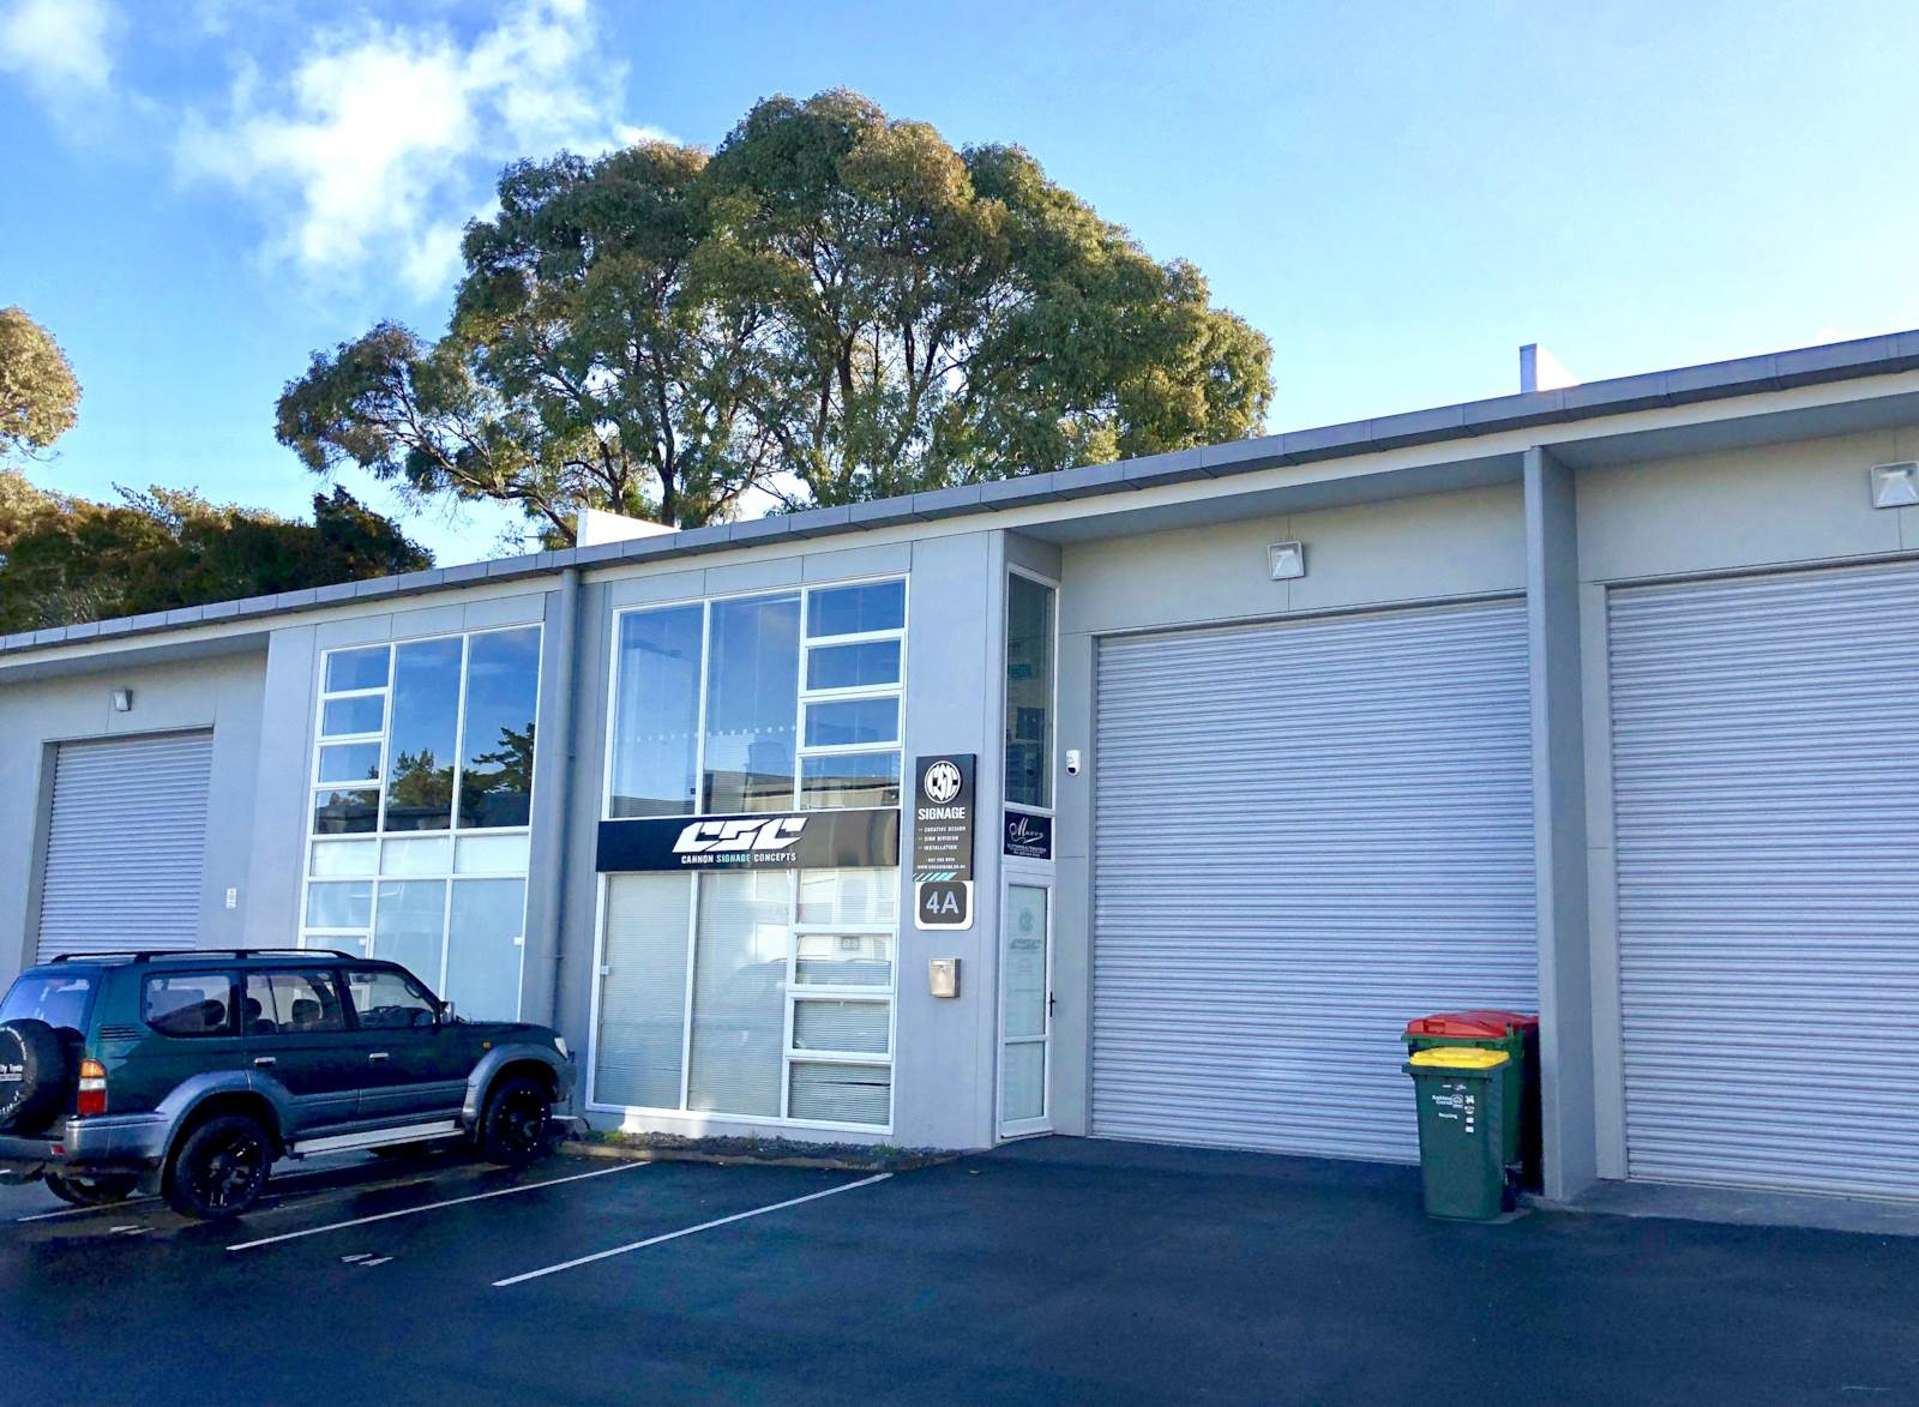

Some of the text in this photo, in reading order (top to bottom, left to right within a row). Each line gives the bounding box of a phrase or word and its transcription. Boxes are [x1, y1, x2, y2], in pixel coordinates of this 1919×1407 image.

[918, 807, 966, 820] SIGNAGE
[672, 817, 809, 853] CSC
[681, 852, 797, 864] CANNON SIGNAGE CONCEPTS
[926, 890, 960, 914] 4A
